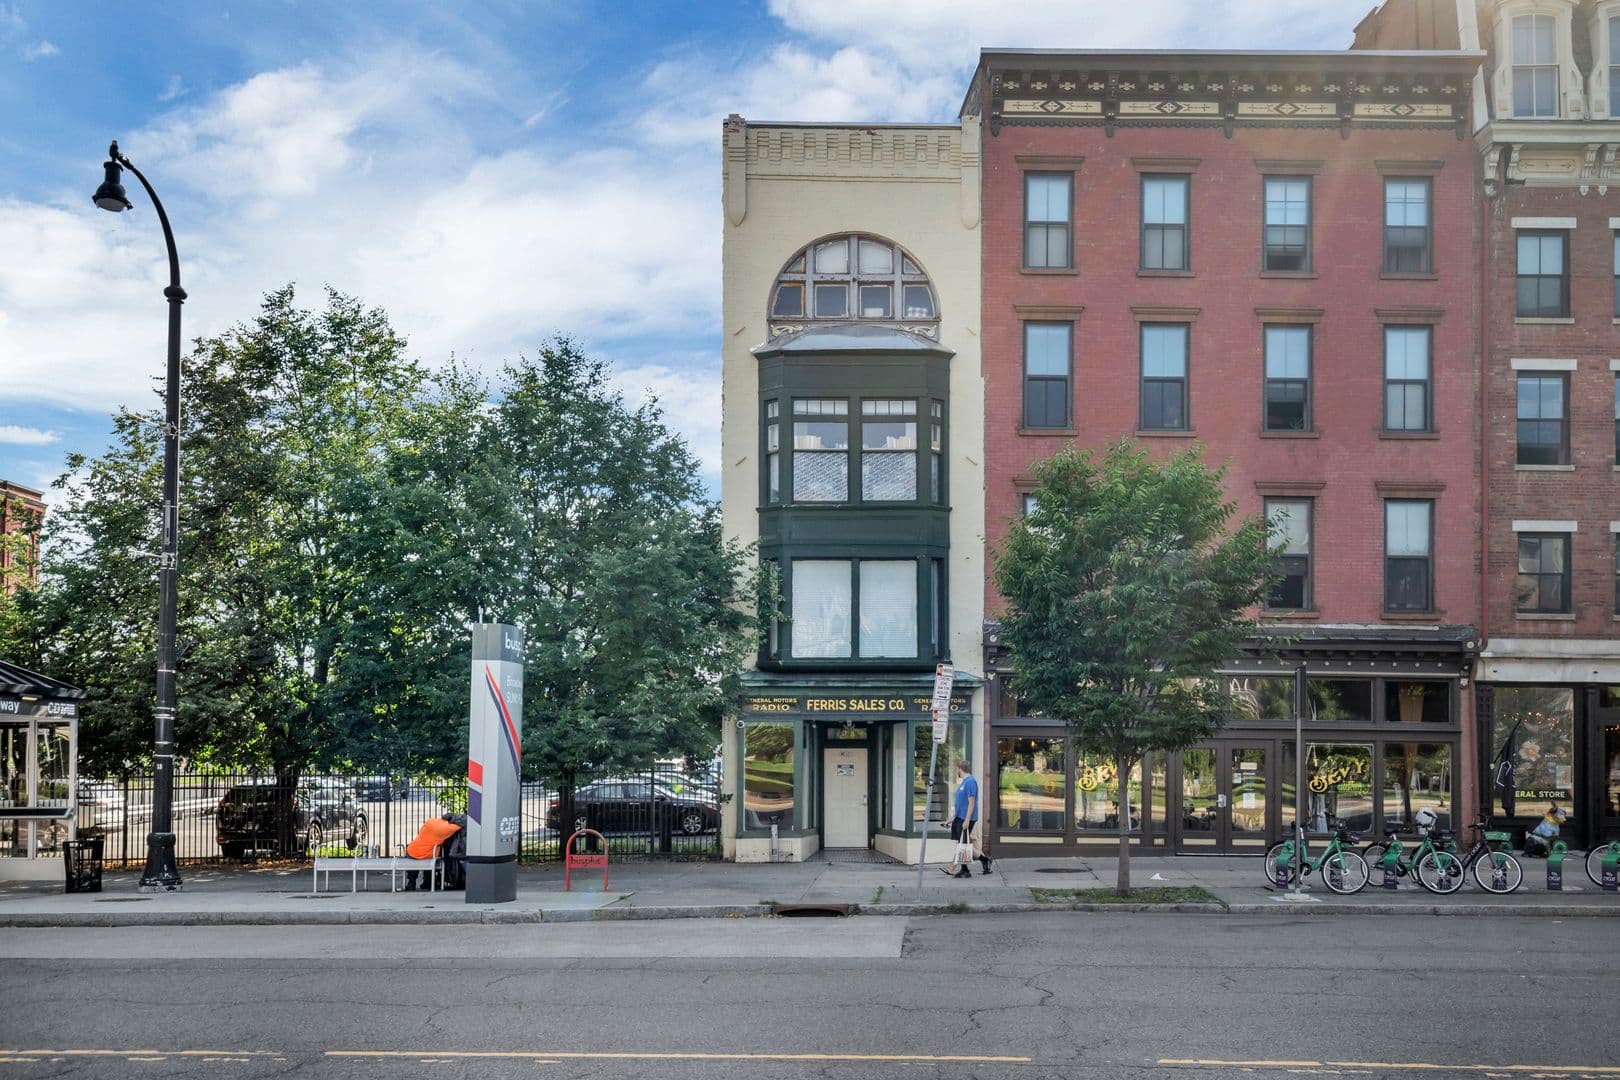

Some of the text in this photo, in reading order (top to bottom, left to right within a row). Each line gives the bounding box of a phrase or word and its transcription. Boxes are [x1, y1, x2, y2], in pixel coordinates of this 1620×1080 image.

[752, 703, 790, 711] RADIO
[807, 699, 905, 711] FERRIS SALES CO.
[1515, 790, 1566, 798] ERAL STORE
